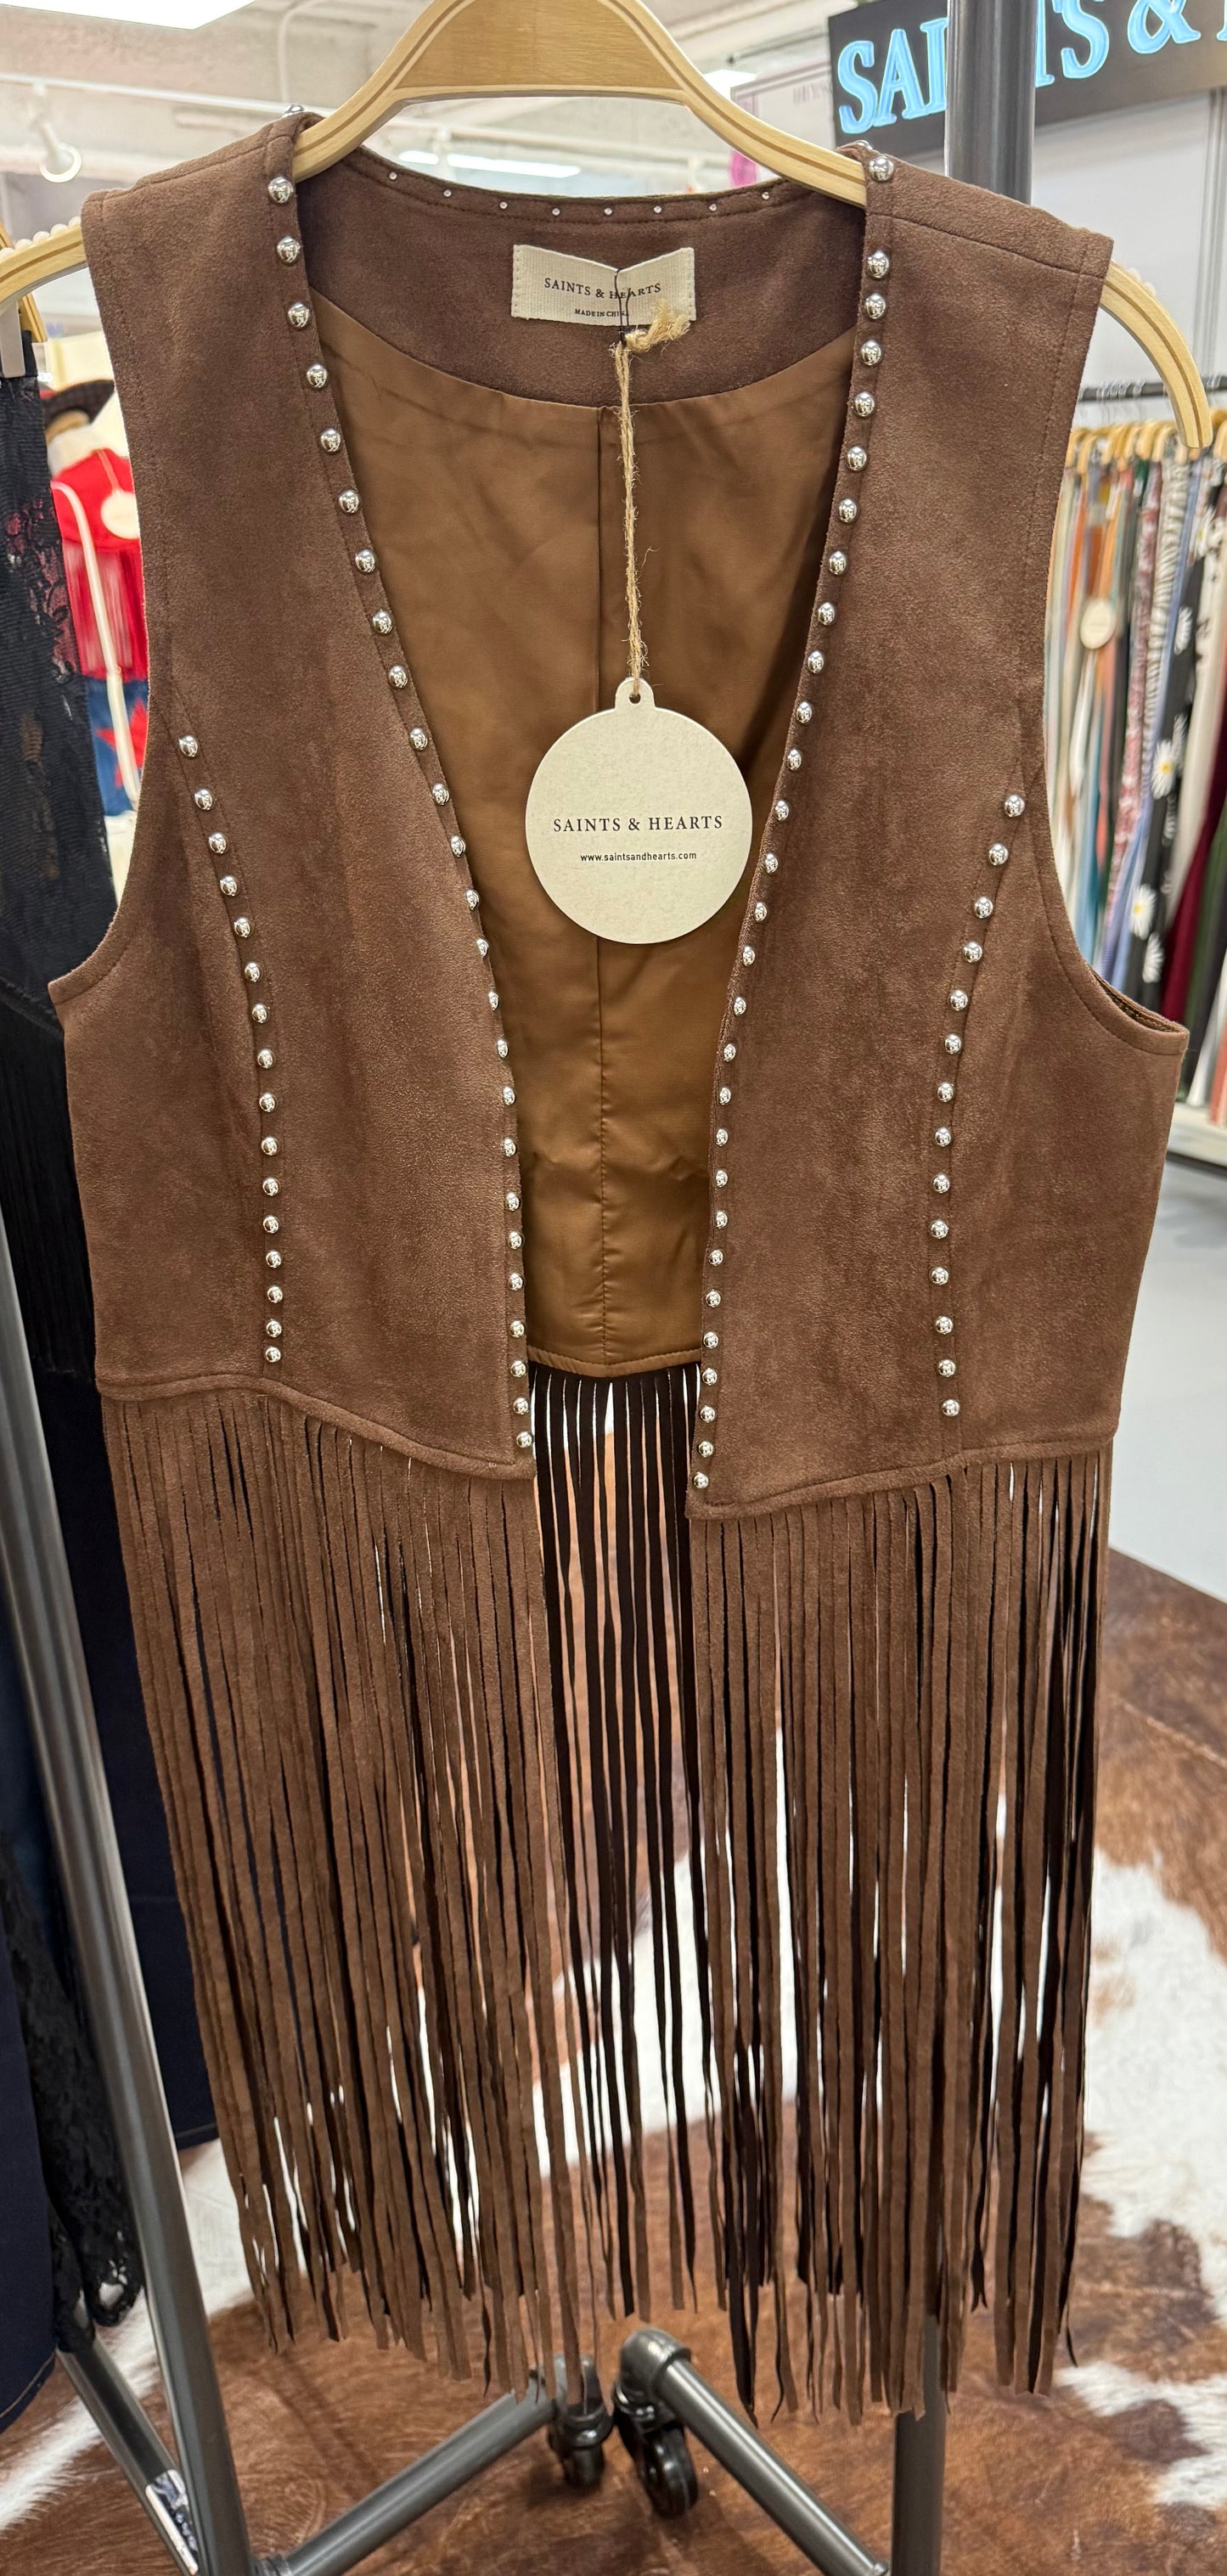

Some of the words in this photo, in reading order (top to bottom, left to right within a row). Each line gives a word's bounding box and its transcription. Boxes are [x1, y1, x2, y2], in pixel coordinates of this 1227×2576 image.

[544, 278, 591, 296] SAINTS
[595, 289, 605, 299] &
[610, 283, 661, 299] HEARTS
[575, 308, 595, 317] MADE
[553, 818, 621, 832] SAINTS
[628, 818, 640, 830] &
[649, 815, 723, 830] HEARTS
[580, 852, 697, 862] www.saintsandhearts.com
